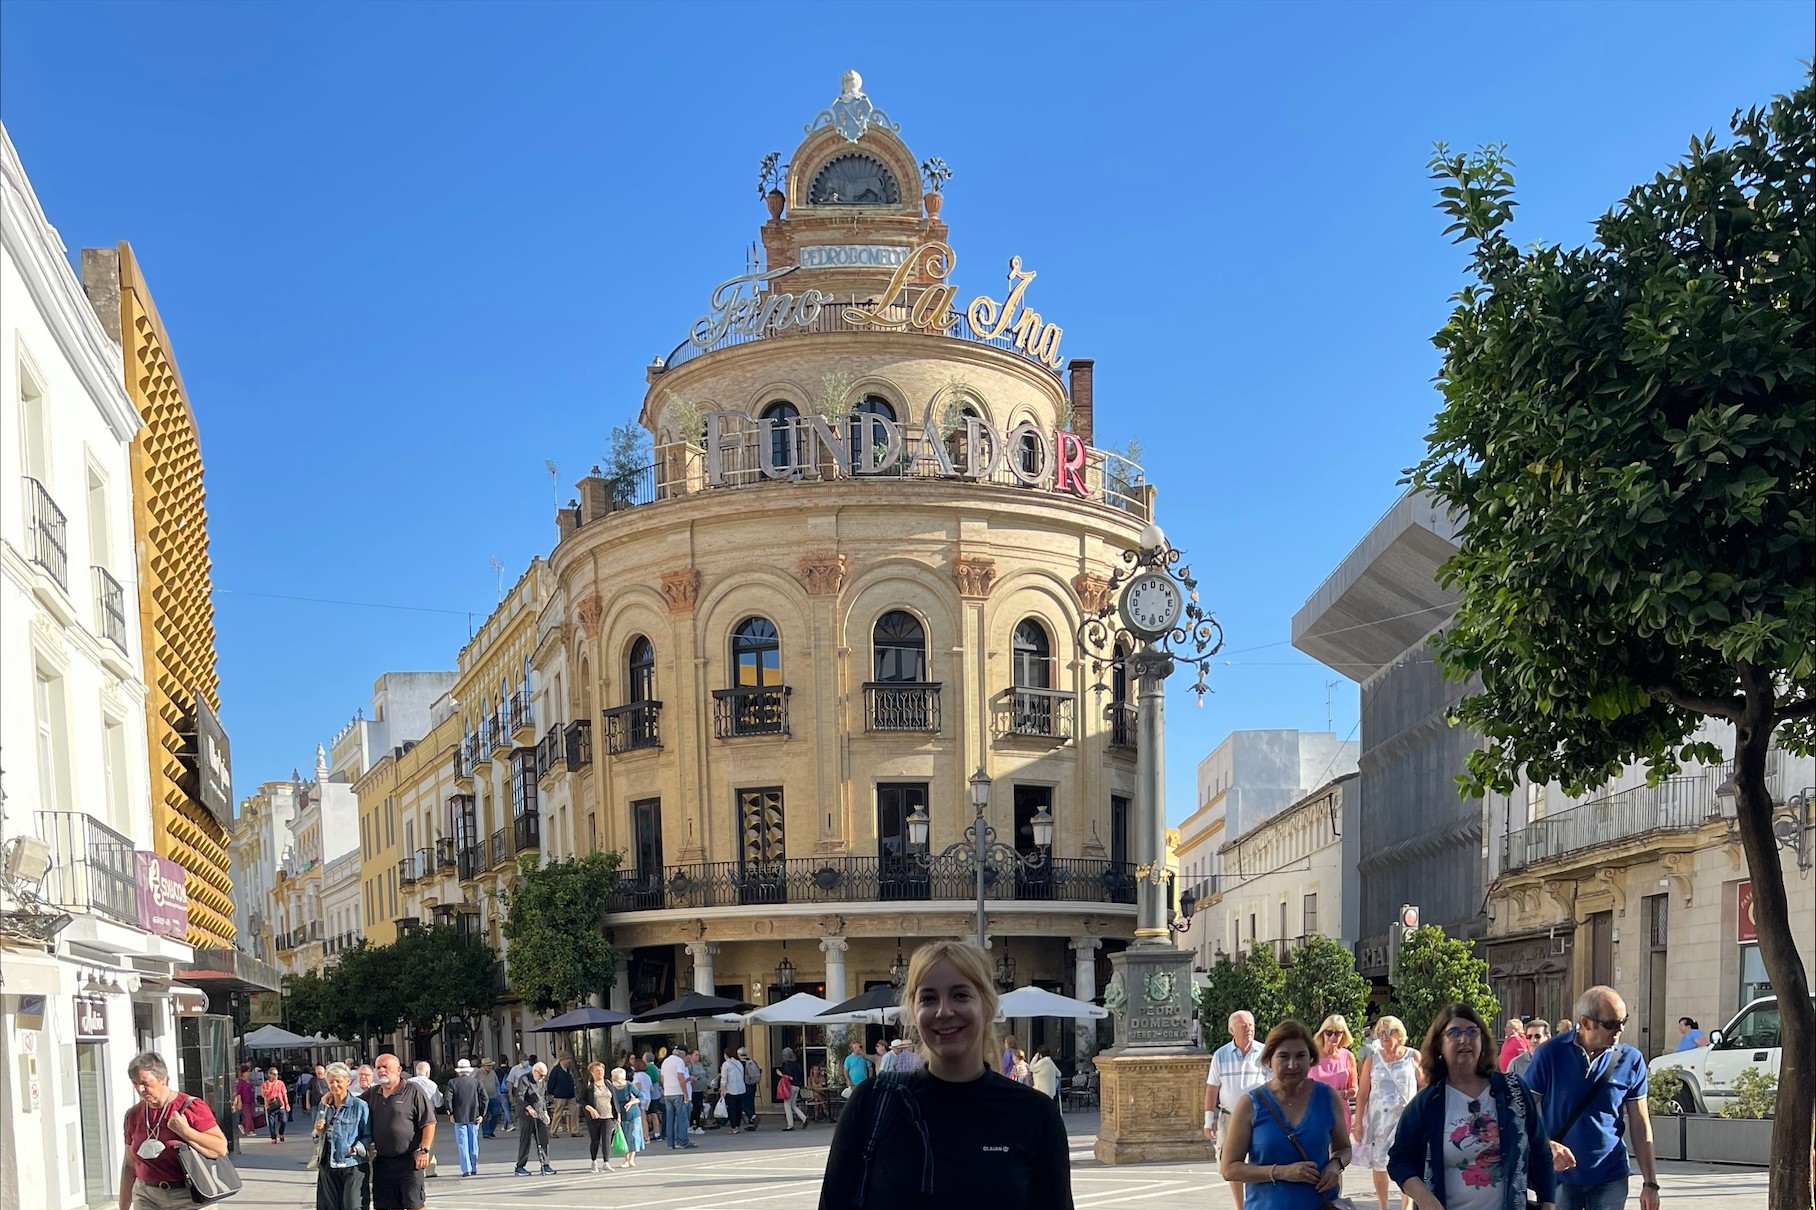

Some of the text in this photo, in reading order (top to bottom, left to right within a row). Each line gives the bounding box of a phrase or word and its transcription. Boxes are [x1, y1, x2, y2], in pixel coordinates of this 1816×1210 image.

[801, 248, 849, 267] PEDRO
[689, 265, 834, 349] Fino
[841, 242, 960, 331] La
[705, 410, 1096, 498] FUNDADOR
[1139, 1005, 1180, 1015] PEDRO
[1131, 1017, 1190, 1028] DOMECQ
